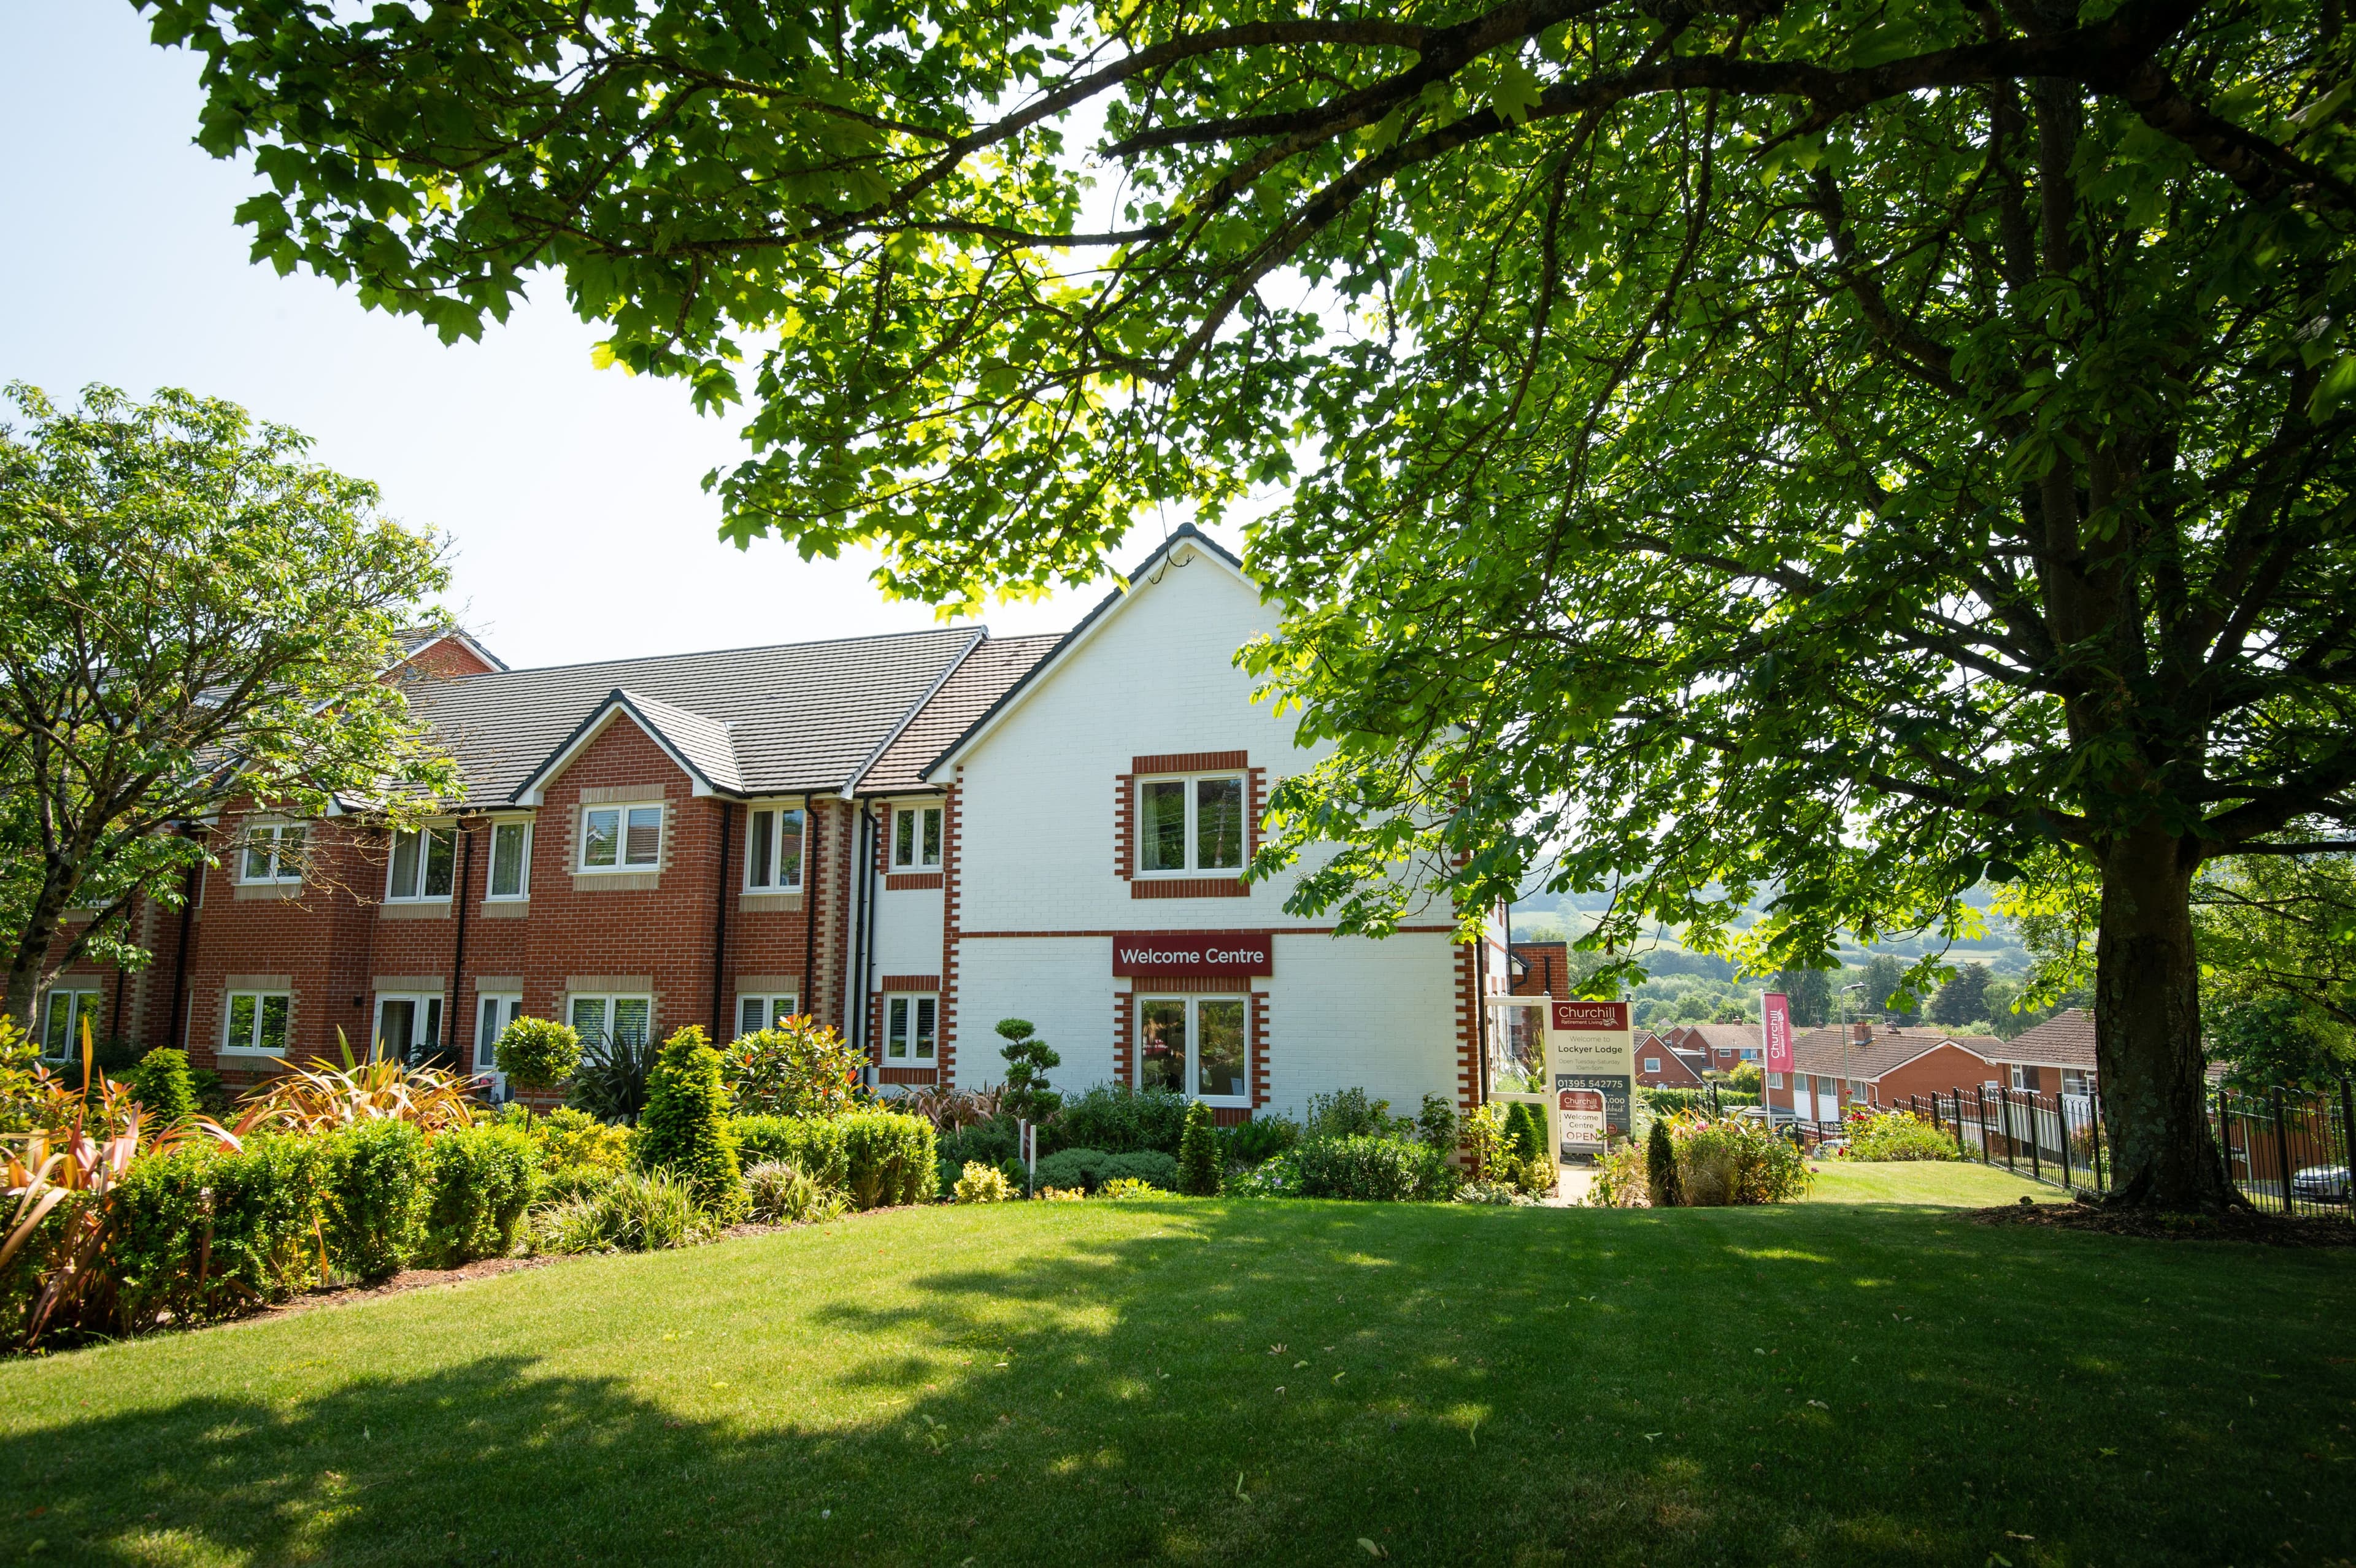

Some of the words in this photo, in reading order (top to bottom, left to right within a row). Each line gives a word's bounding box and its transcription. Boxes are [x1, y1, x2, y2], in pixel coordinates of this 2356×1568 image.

[1120, 948, 1200, 964] Welcome
[1206, 948, 1264, 964] Centre
[1559, 1006, 1615, 1018] Churchill
[1770, 1010, 1780, 1058] Churchill
[1566, 1132, 1598, 1141] OPEN
